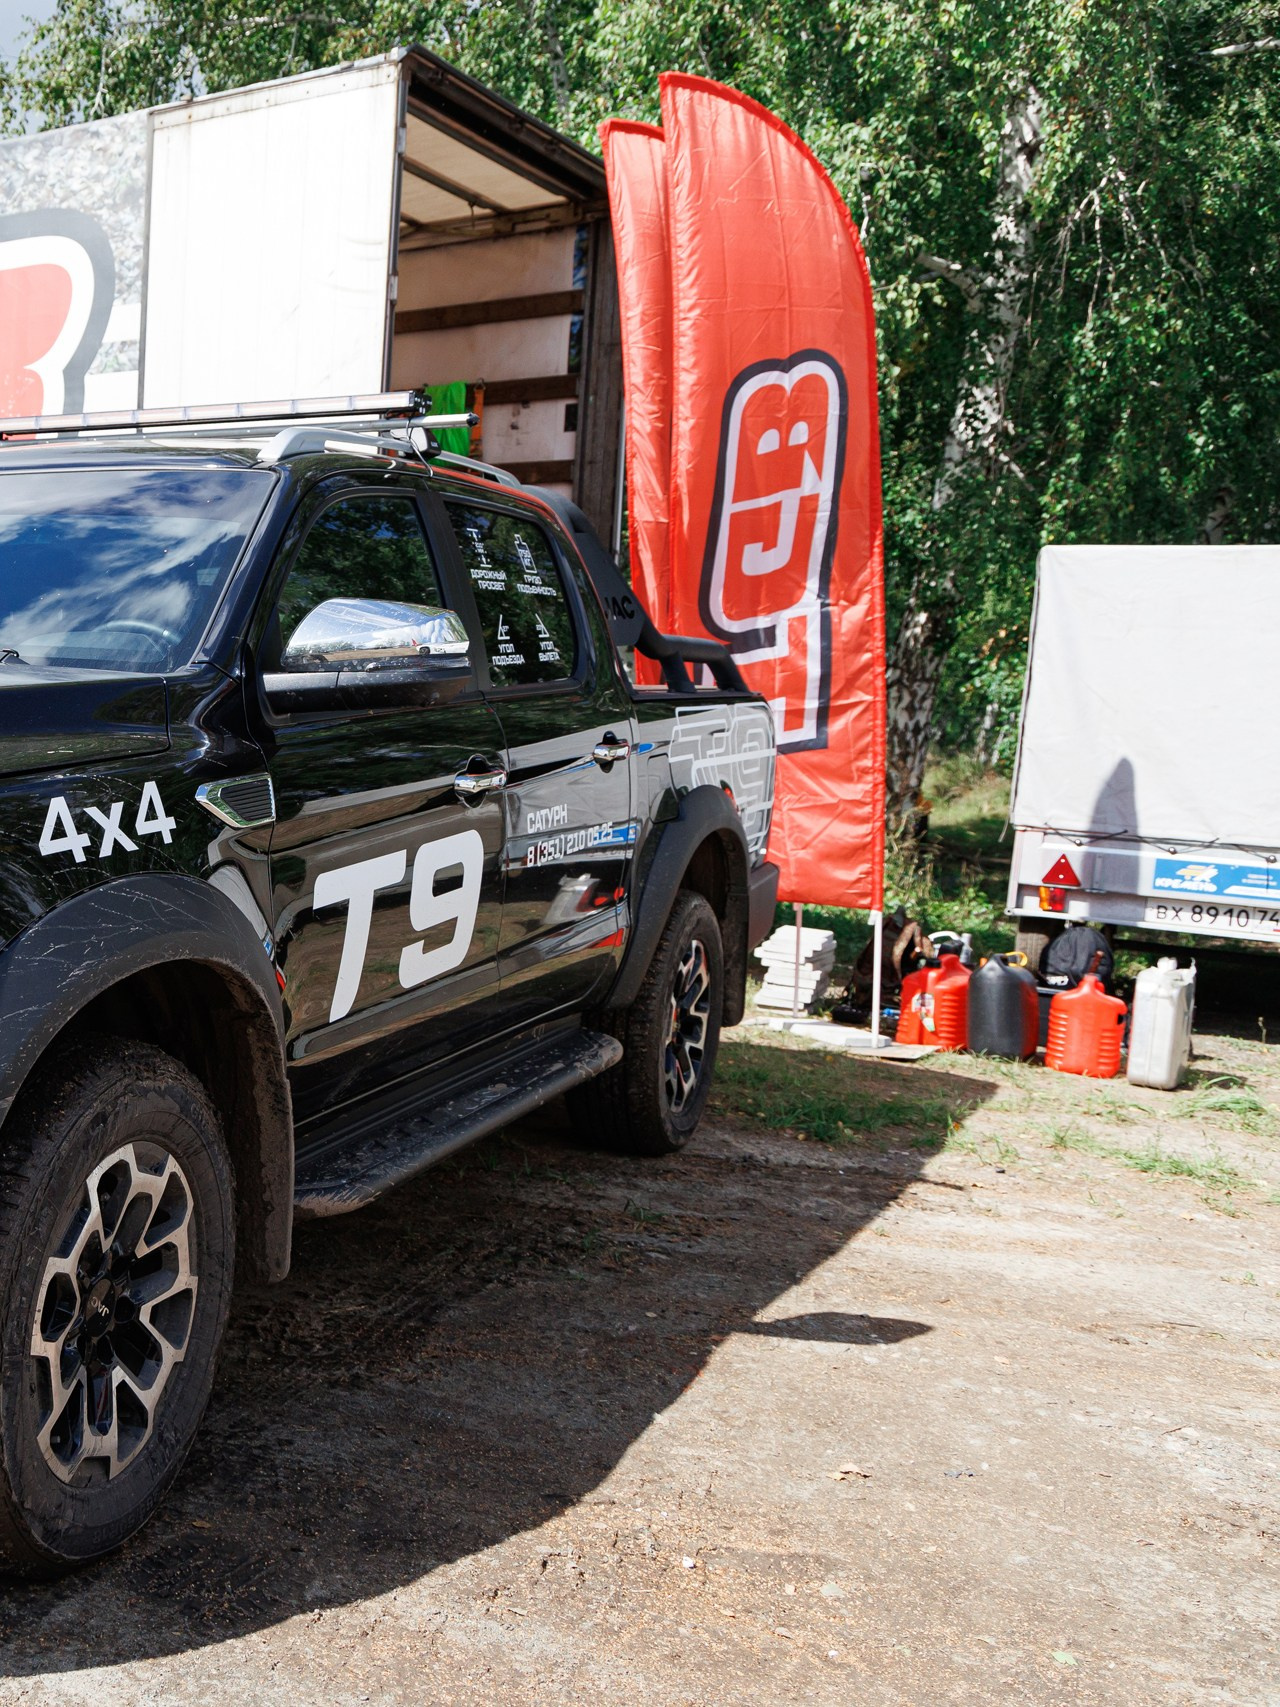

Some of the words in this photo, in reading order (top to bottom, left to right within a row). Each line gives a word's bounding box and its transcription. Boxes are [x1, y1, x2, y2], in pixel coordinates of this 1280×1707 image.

[470, 569, 507, 580] ДОРОЖНЫЙ
[524, 574, 542, 585] ГРУЗО
[478, 580, 505, 591] ПРОСВЕТ
[498, 643, 515, 653] УГОЛ
[539, 641, 555, 650] УГОЛ
[492, 654, 526, 666] ПОДЪЕЗДА
[538, 651, 561, 662] ВЫЛЕТА
[38, 780, 177, 864] 4x4
[526, 803, 568, 834] САТУРН
[526, 845, 535, 868] 8
[537, 834, 565, 867] (351)
[566, 829, 586, 855] 210
[1190, 904, 1250, 928] 8910
[312, 828, 485, 1024] T9
